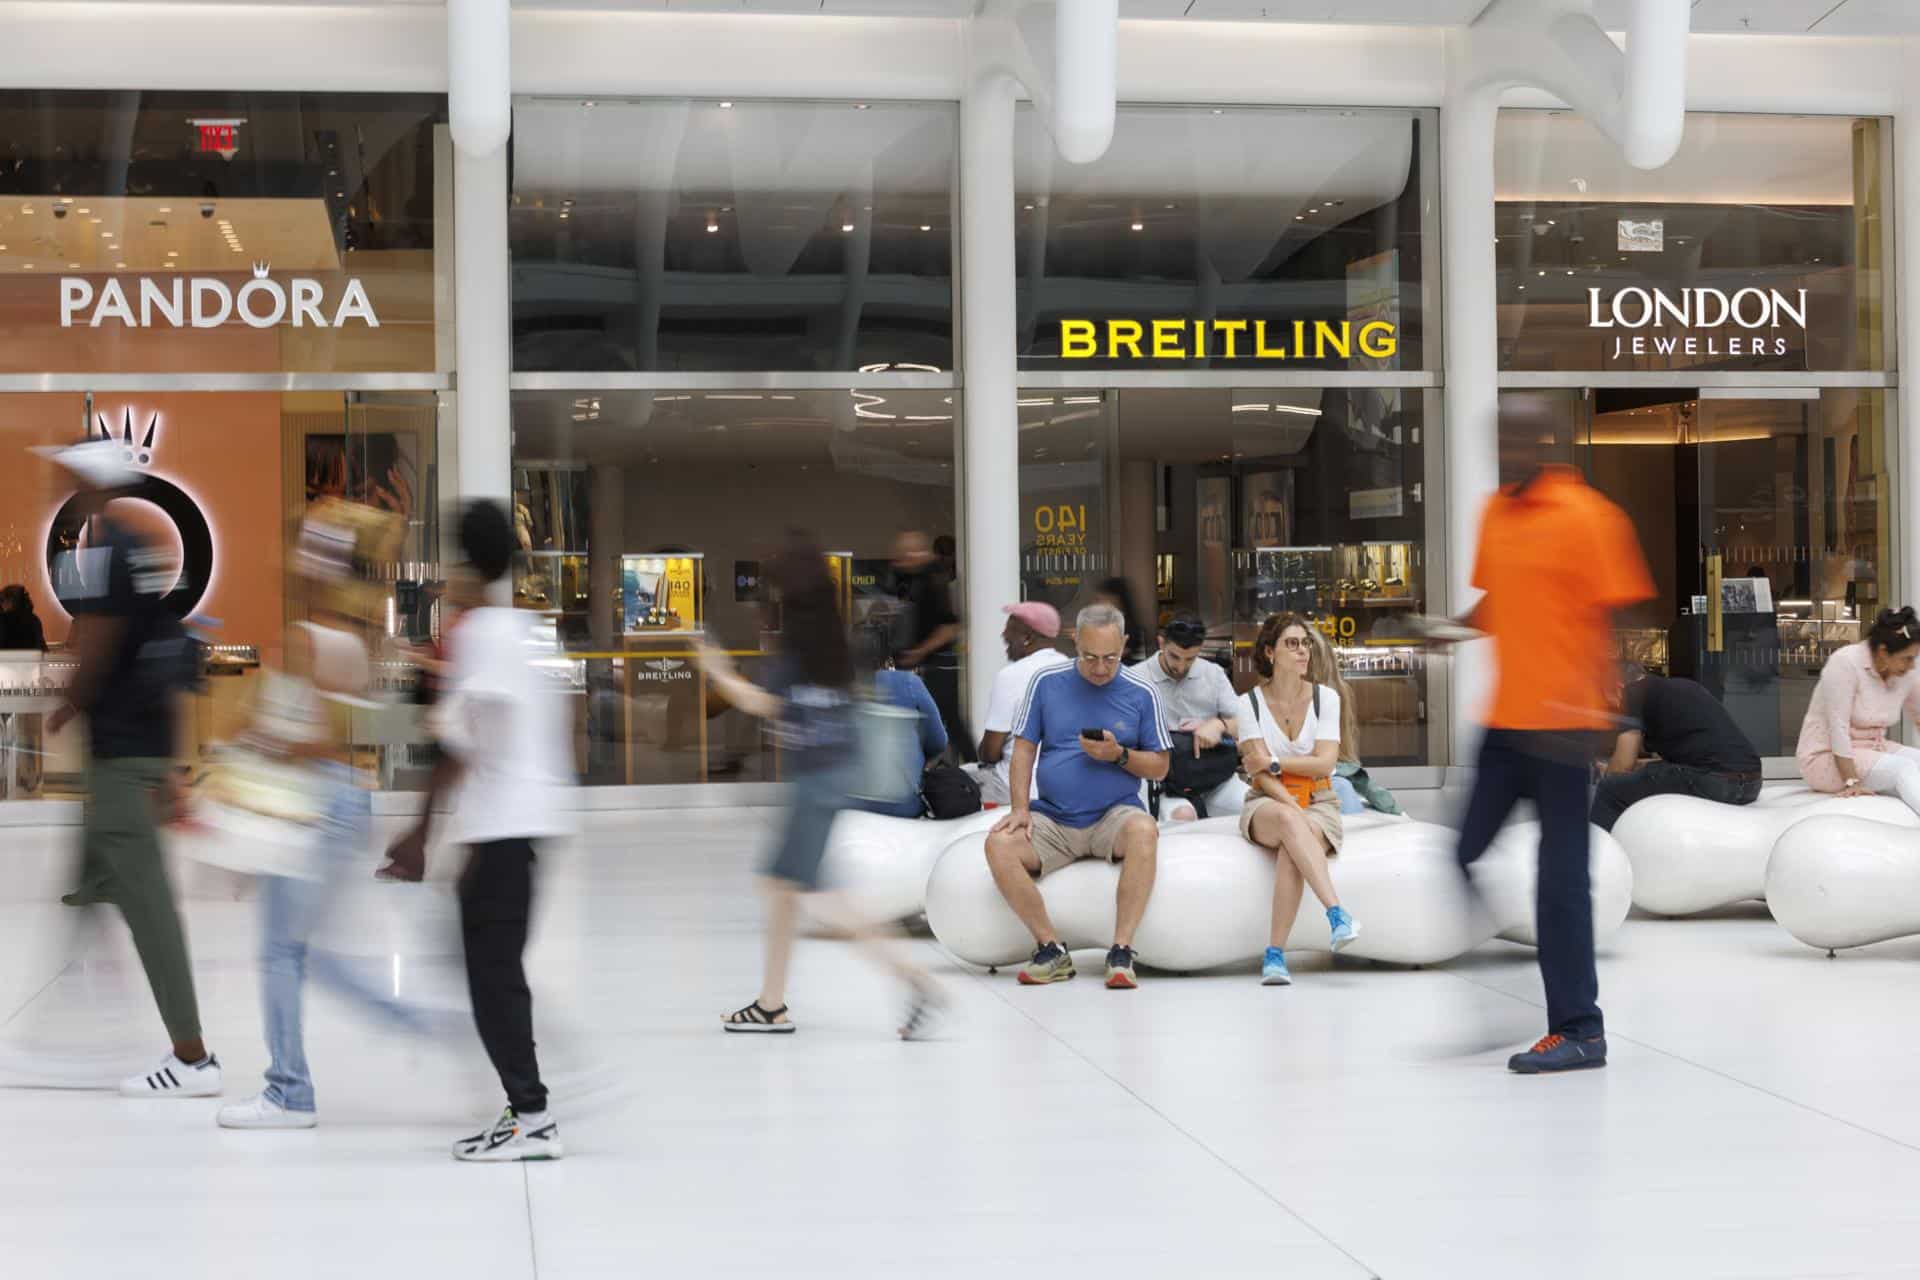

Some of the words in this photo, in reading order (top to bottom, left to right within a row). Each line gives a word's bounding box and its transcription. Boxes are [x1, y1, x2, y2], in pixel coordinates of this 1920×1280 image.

[60, 272, 381, 328] PANDORA
[1587, 286, 1808, 329] LONDON
[1059, 318, 1398, 360] BREITLING
[1612, 336, 1787, 359] JEWELERS
[670, 580, 690, 592] 140
[638, 670, 692, 681] BREITLING
